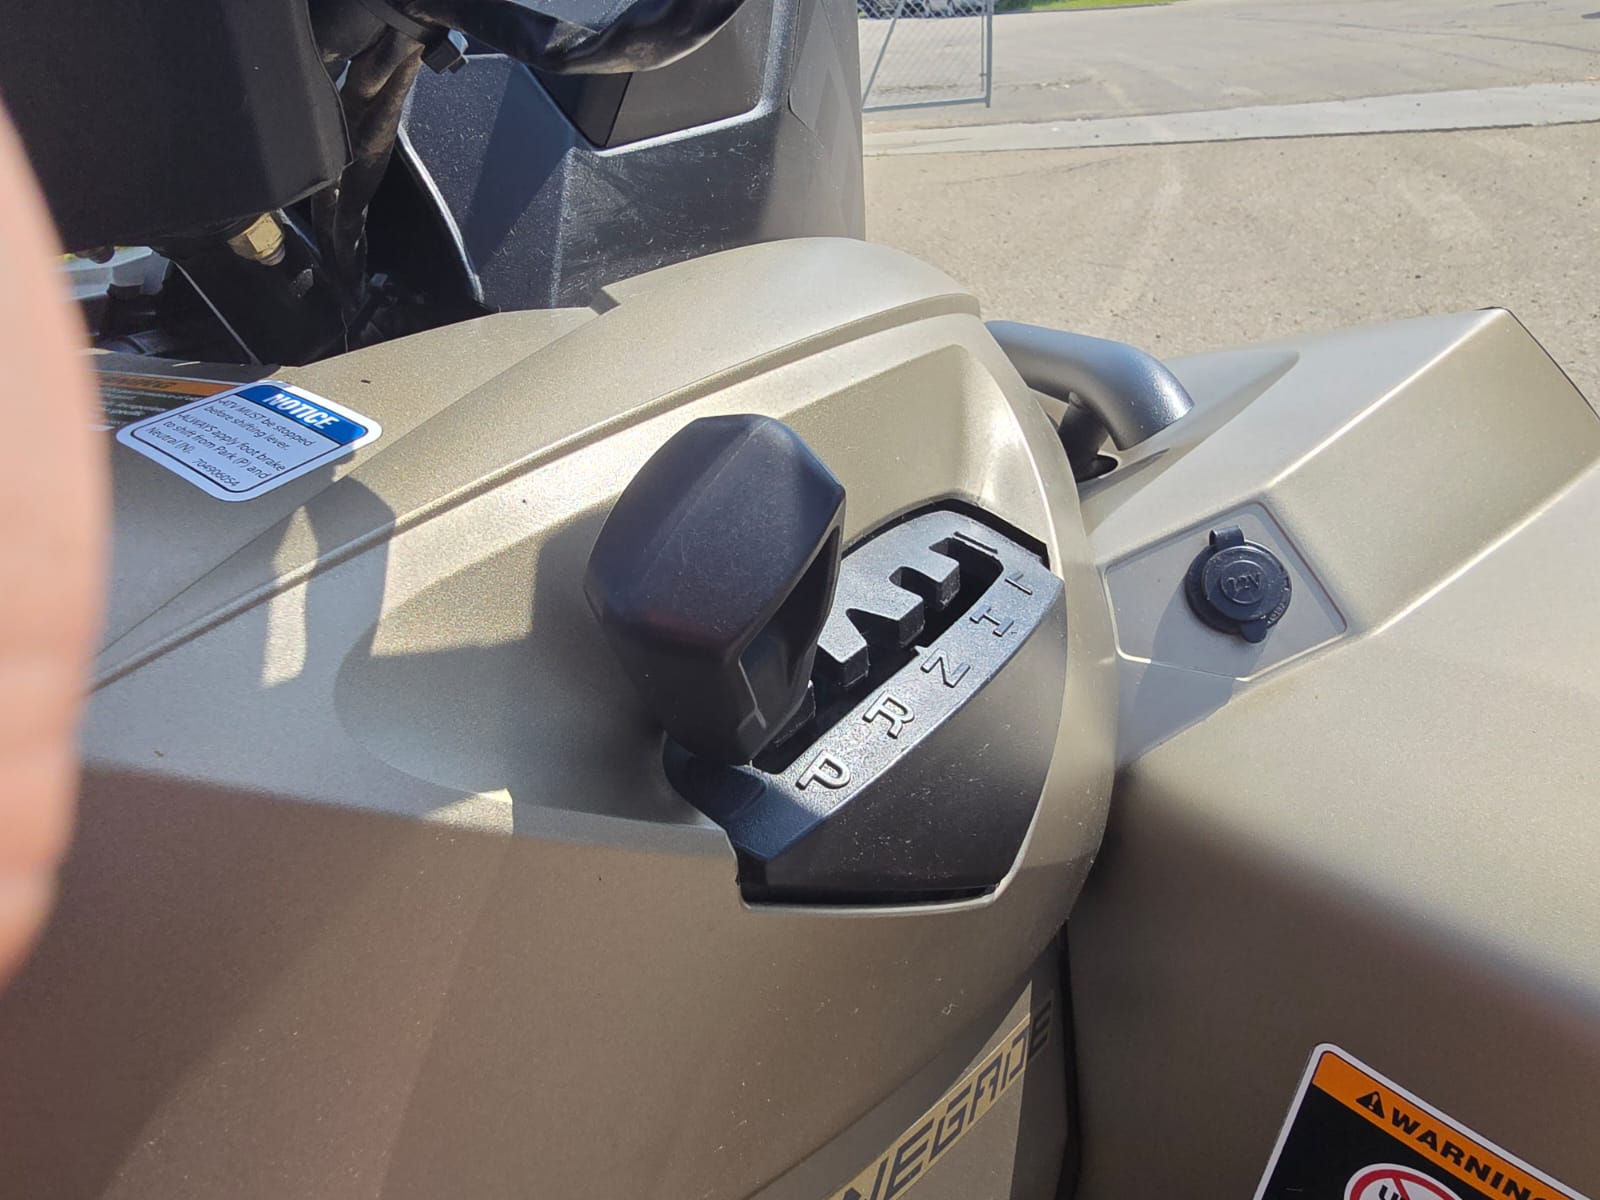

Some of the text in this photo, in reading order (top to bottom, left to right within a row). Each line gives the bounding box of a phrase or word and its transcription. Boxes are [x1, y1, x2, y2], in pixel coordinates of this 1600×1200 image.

[203, 406, 233, 421] before
[231, 417, 267, 439] shifting
[238, 405, 266, 420] MUST
[261, 417, 276, 428] be
[273, 425, 316, 447] stopped
[262, 394, 340, 429] NOTICE
[147, 427, 181, 446] Neutral
[163, 420, 273, 480] to shift from Park (P) and
[211, 429, 241, 446] apply
[238, 442, 260, 456] foot
[255, 453, 286, 472] brake
[1003, 571, 1033, 596] L
[969, 604, 1015, 638] H
[920, 648, 970, 688] N
[863, 691, 915, 739] R
[795, 750, 850, 790] P
